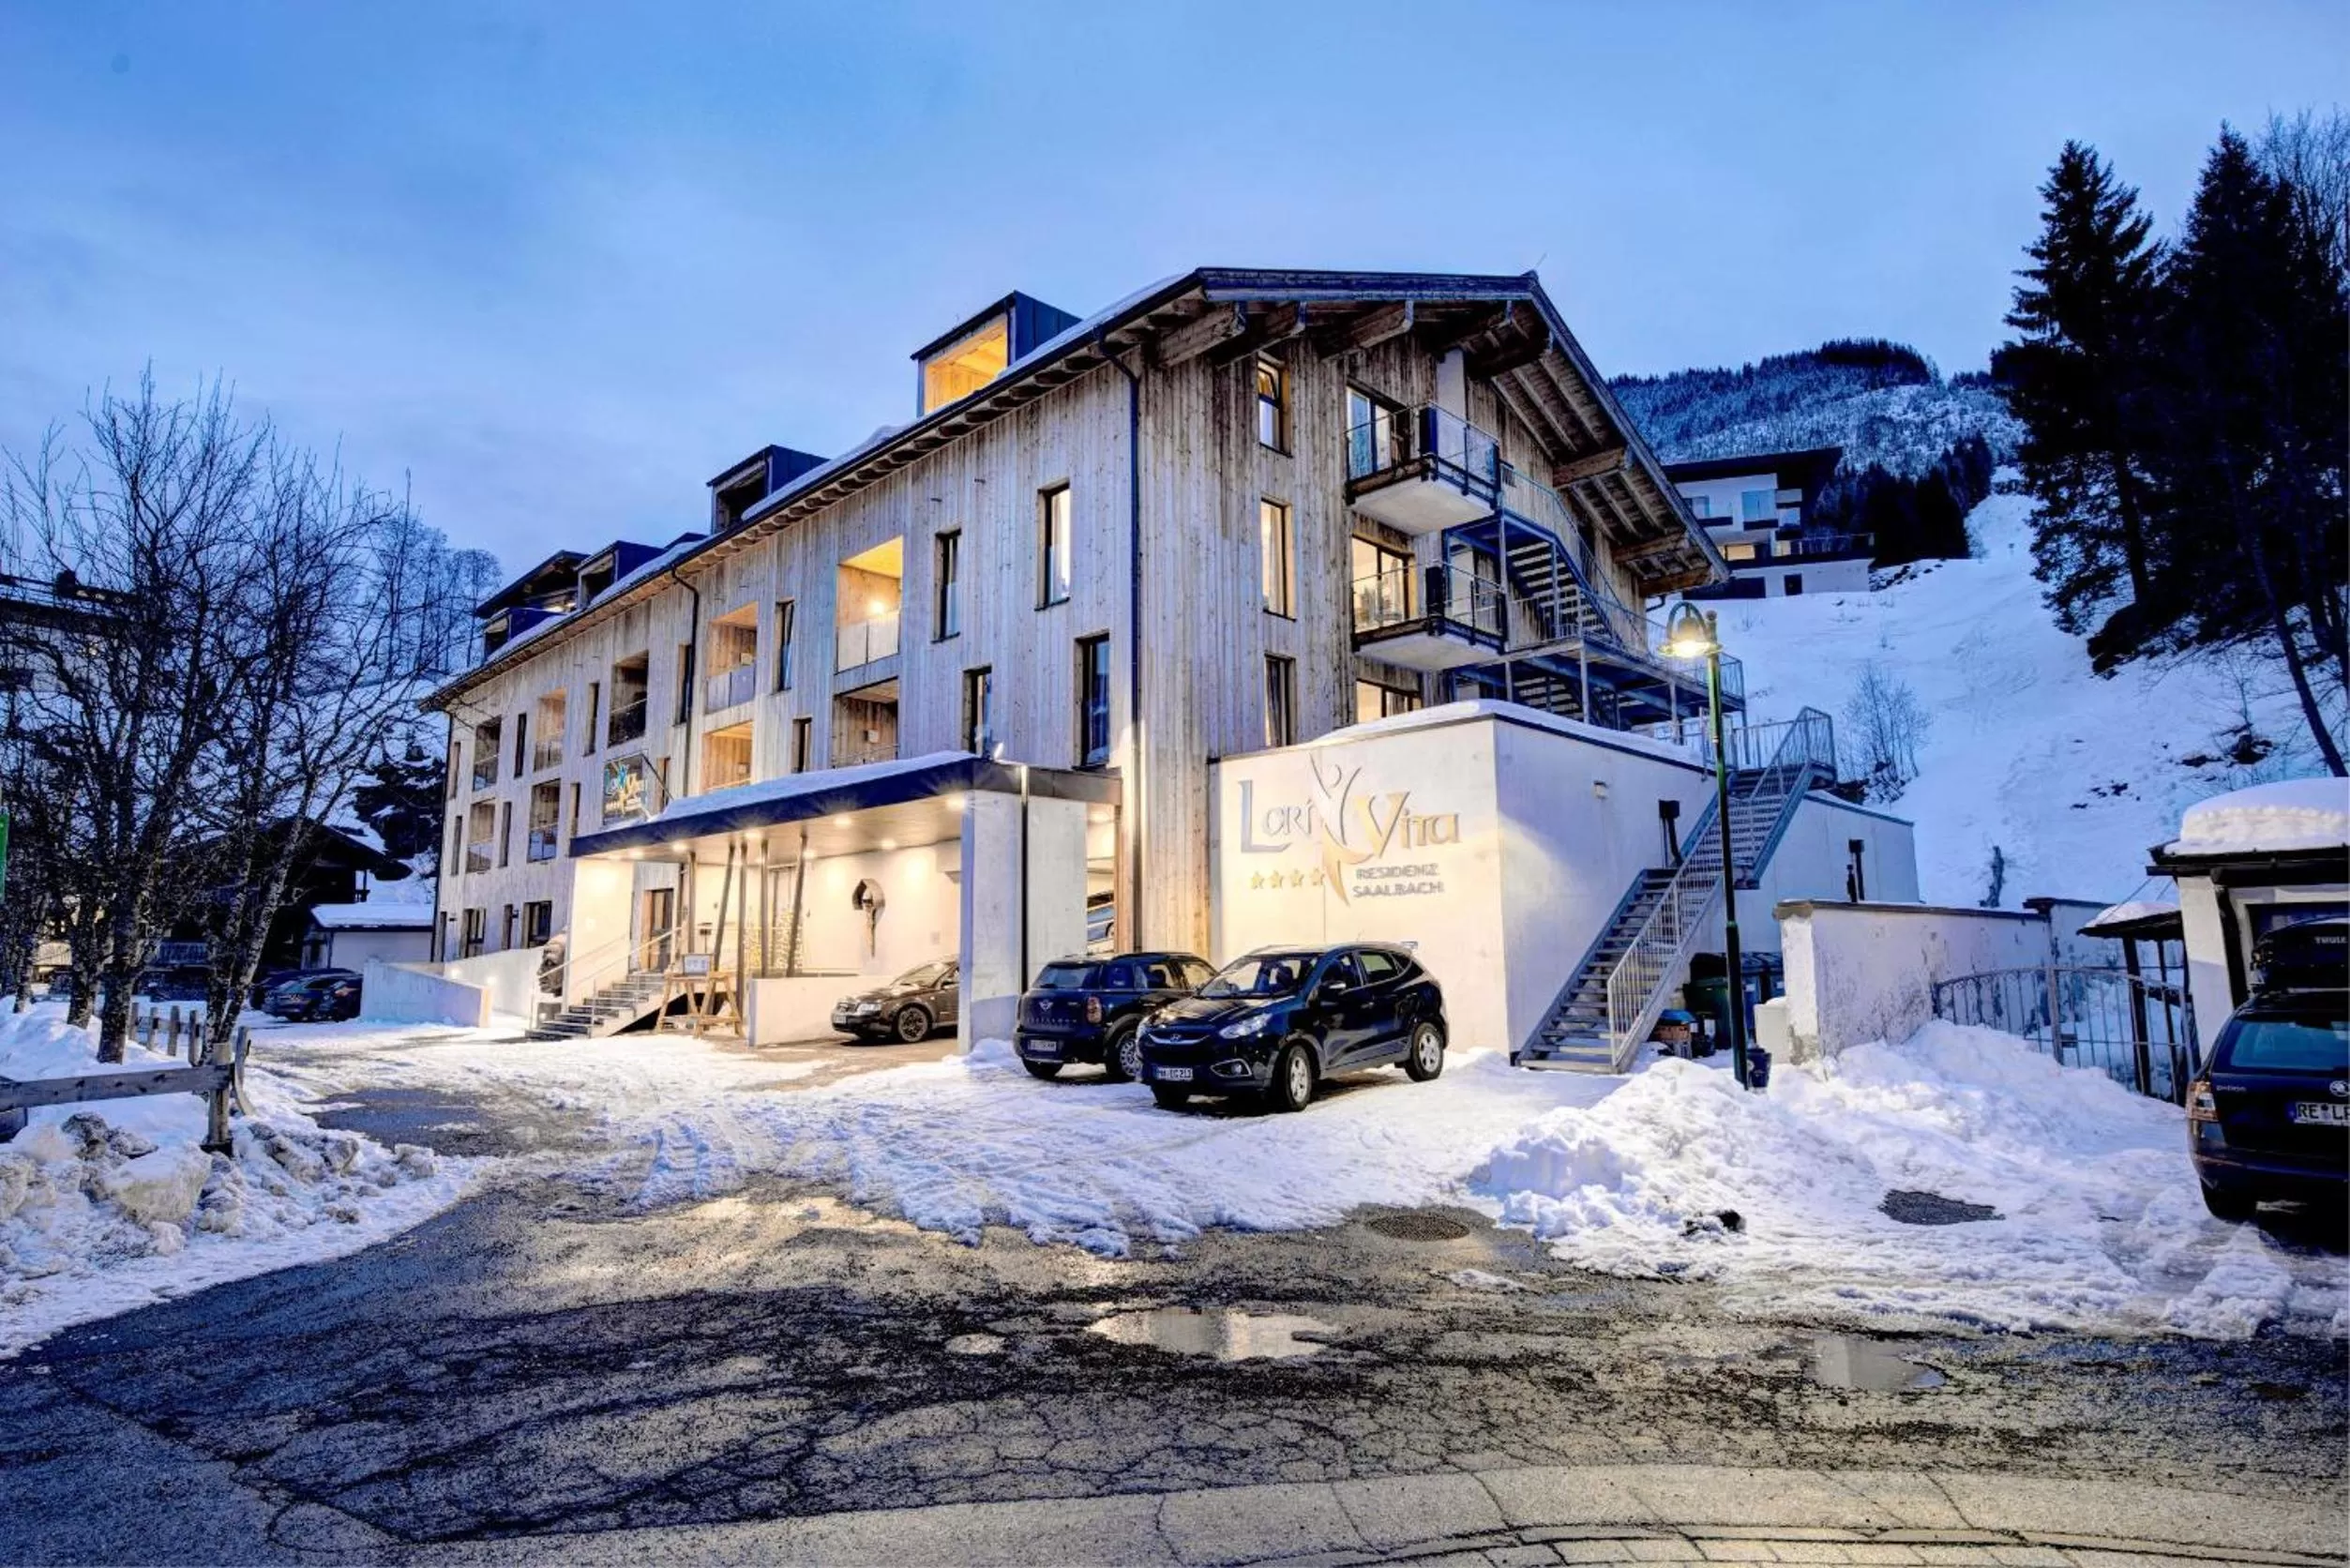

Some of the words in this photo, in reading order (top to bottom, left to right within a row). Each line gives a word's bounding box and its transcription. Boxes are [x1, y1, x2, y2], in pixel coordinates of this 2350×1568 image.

[1356, 864, 1439, 880] RESIDENZ
[1352, 882, 1444, 897] SAALBACH
[2297, 1104, 2319, 1119] RE
